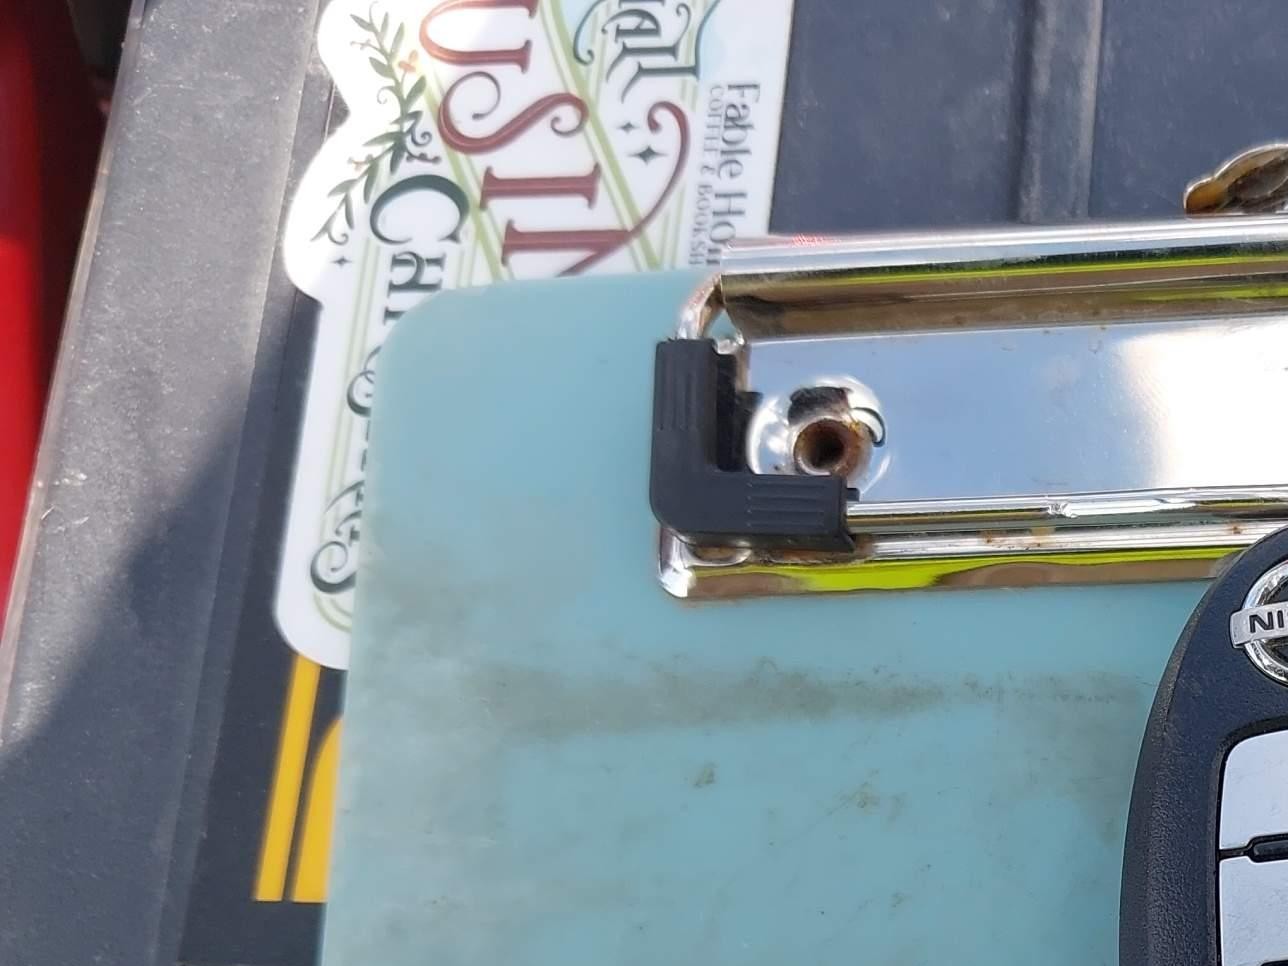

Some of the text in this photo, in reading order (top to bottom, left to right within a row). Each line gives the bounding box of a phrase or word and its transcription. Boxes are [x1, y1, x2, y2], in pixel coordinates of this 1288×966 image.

[703, 85, 724, 152] COFFEE
[717, 83, 760, 179] Fable
[700, 164, 716, 176] &
